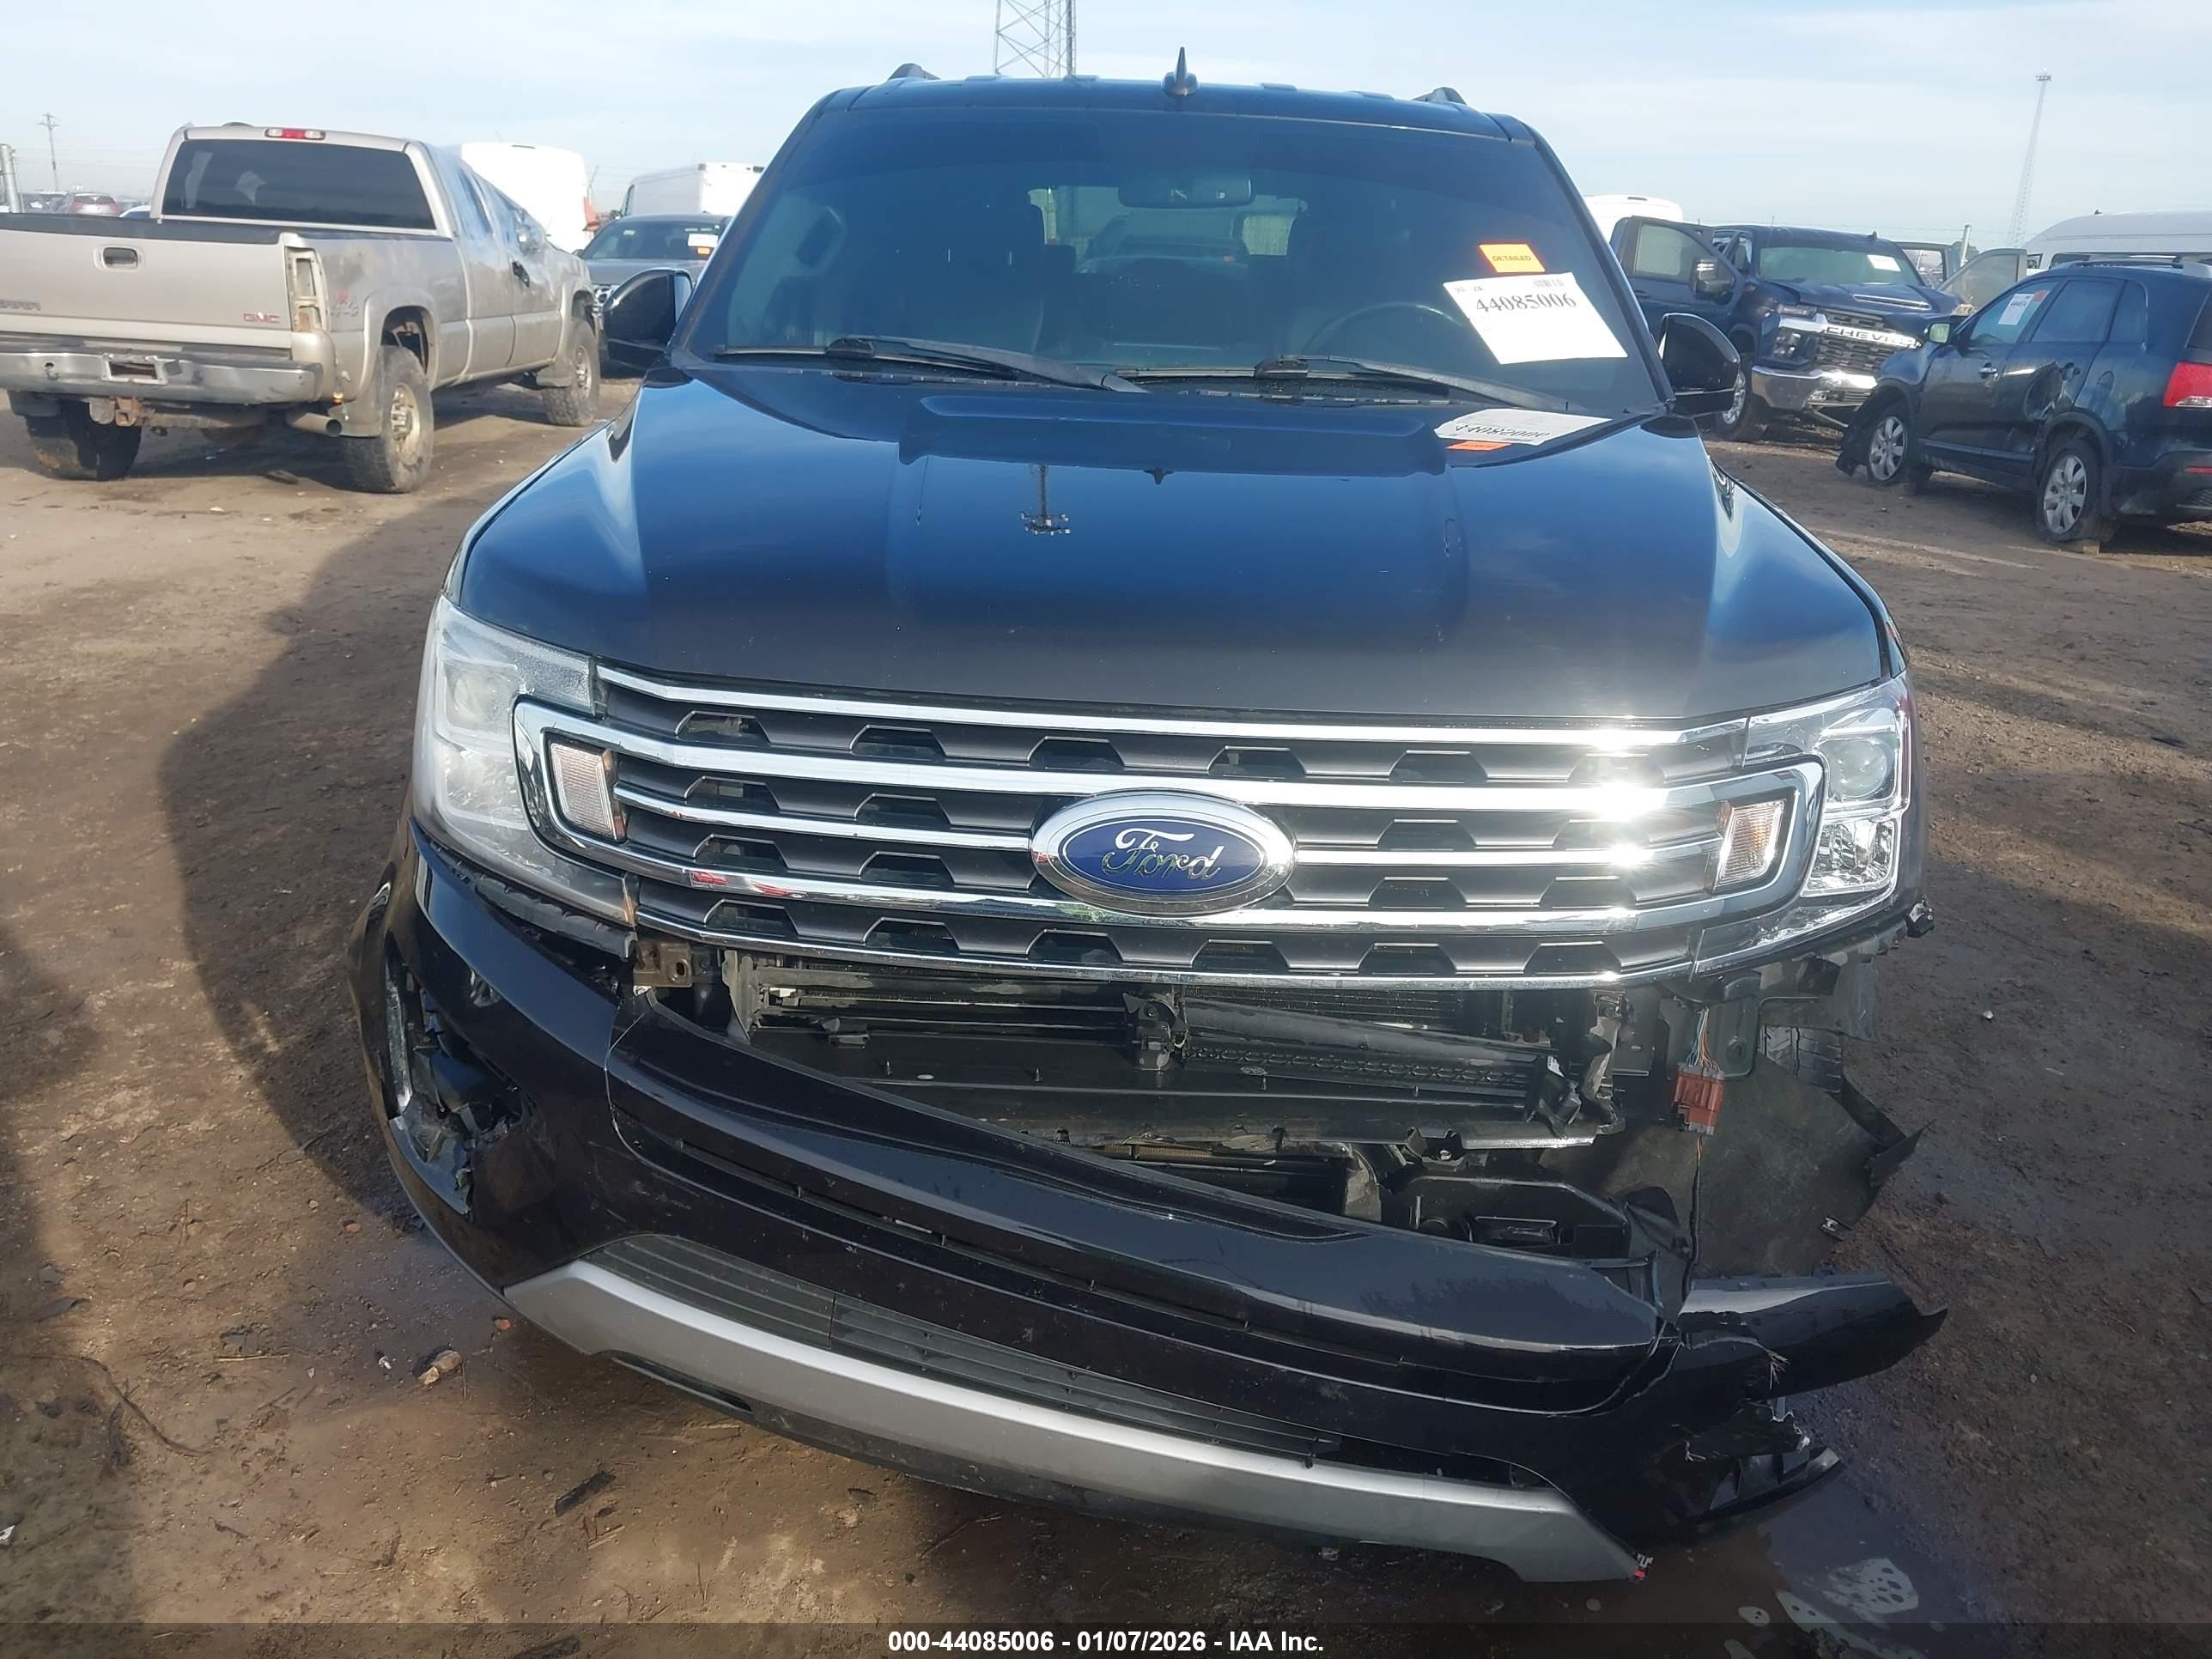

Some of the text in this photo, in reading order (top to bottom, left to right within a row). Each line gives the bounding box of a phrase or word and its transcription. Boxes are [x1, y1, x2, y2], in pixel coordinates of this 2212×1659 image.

[1476, 293, 1577, 312] 44085006
[243, 313, 280, 324] GMC
[1102, 828, 1225, 881] Ford
